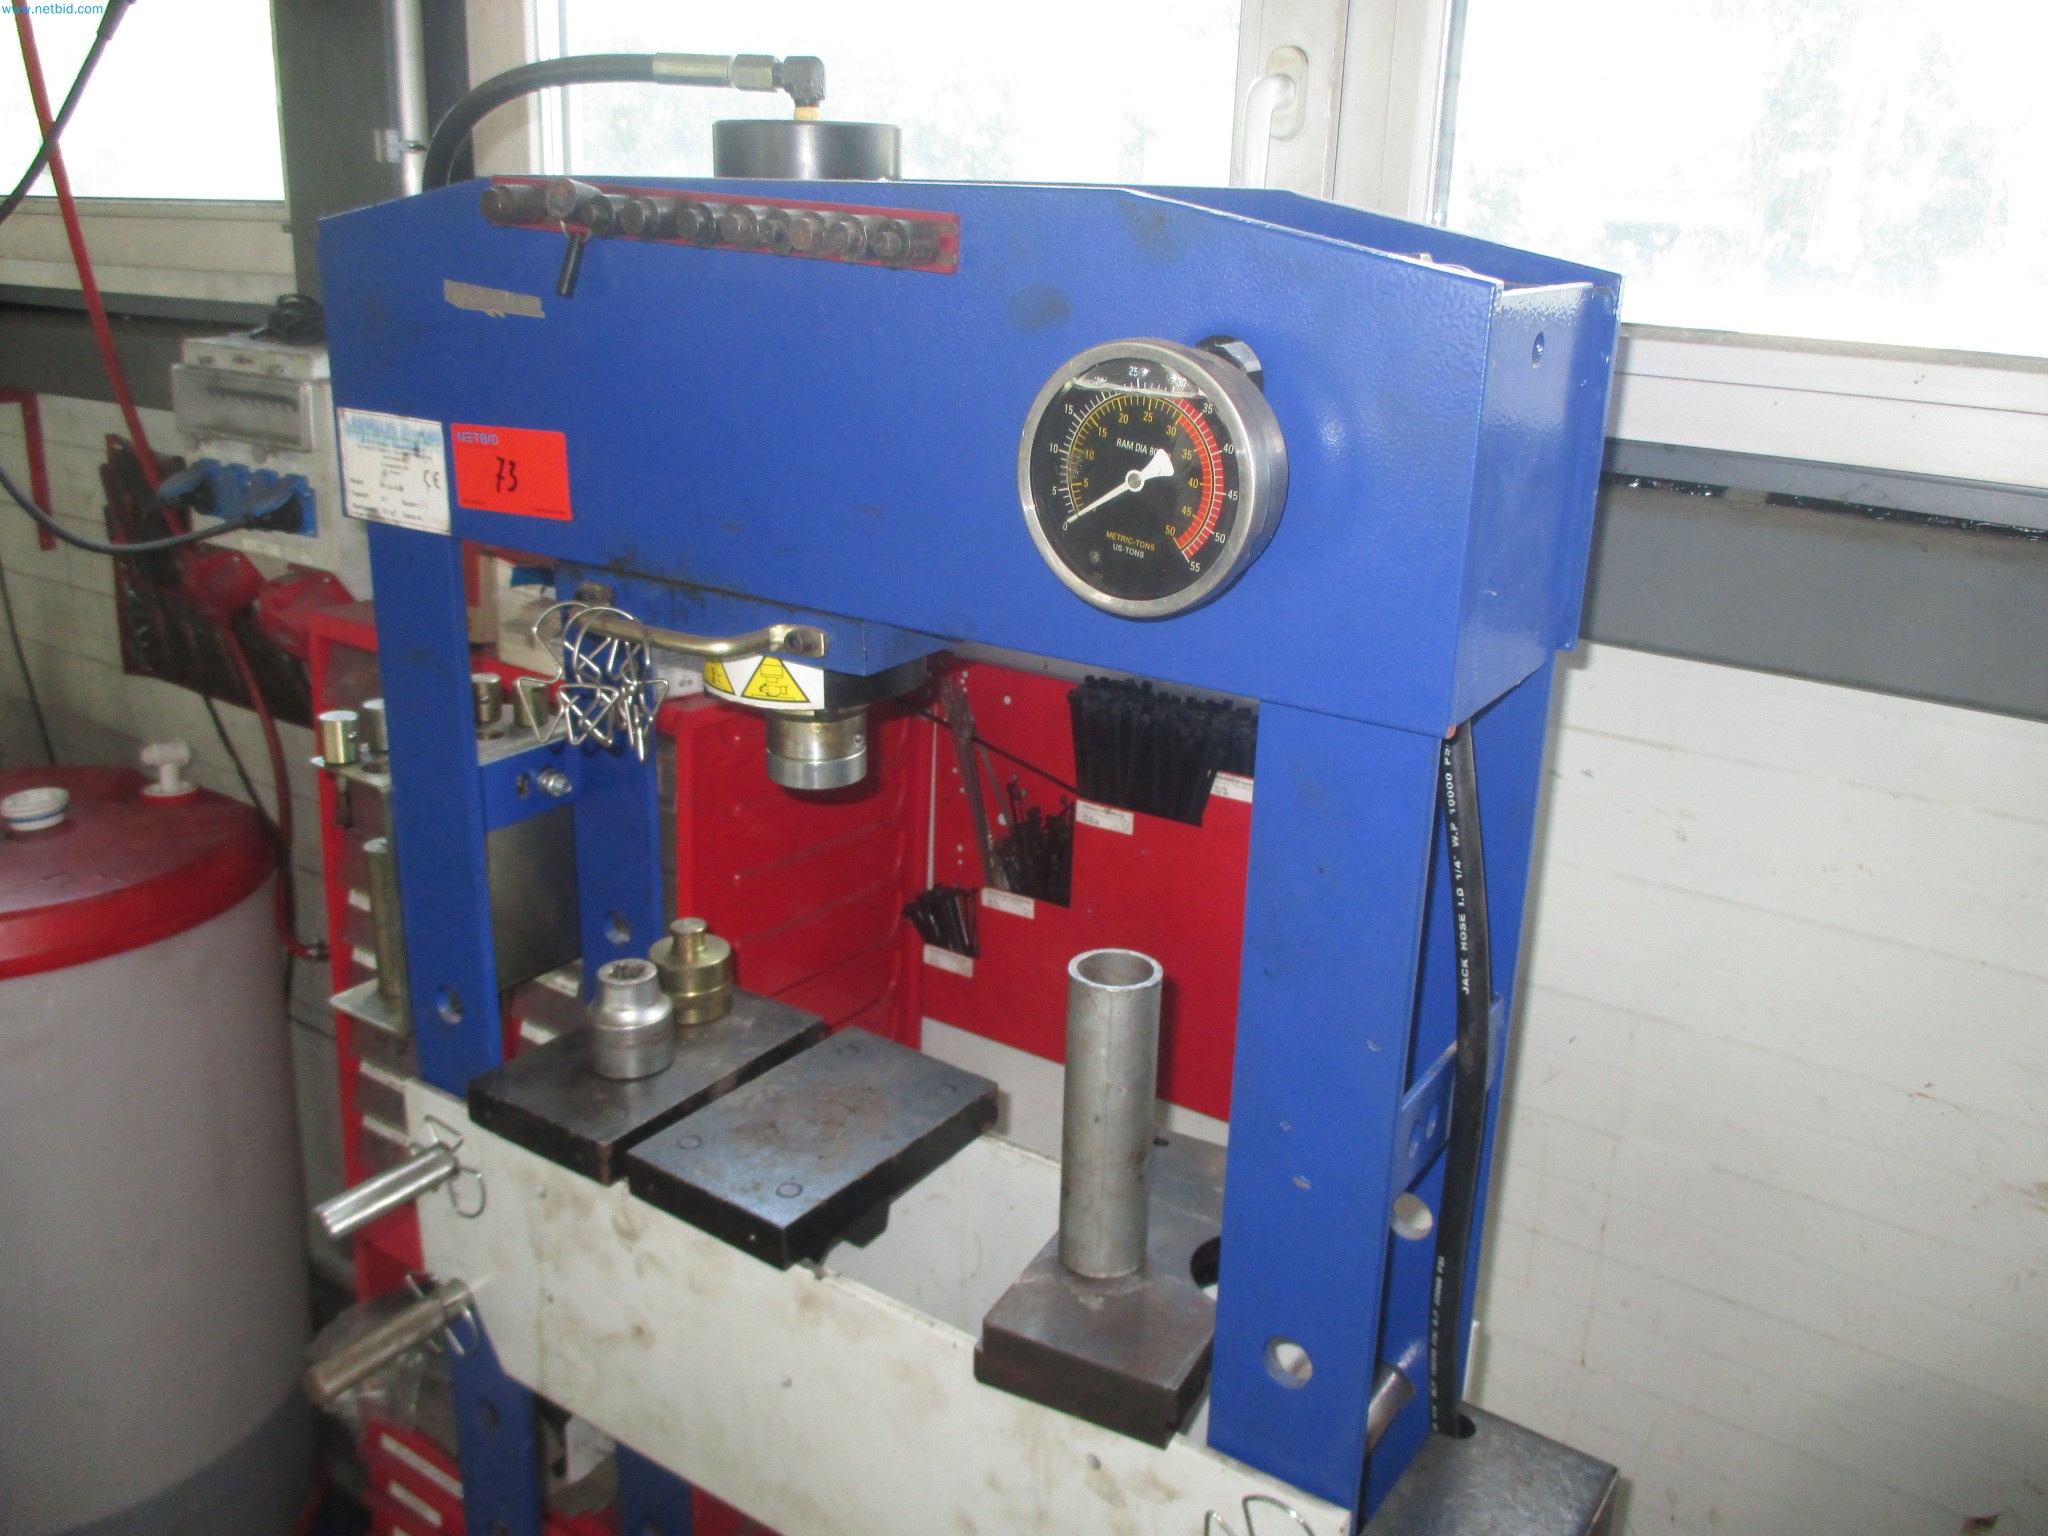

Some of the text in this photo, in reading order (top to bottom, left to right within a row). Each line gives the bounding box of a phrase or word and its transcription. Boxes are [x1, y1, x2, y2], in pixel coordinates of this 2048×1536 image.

[1128, 365, 1139, 378] 25
[1177, 377, 1187, 388] 30
[1064, 403, 1074, 415] 15
[1202, 402, 1214, 415] 35
[1118, 412, 1129, 424] 20
[1142, 411, 1153, 423] 25
[1098, 426, 1108, 438] 15
[1165, 425, 1177, 437] 30
[456, 431, 499, 446] NETBID
[1049, 443, 1059, 454] 10
[1116, 437, 1134, 451] RAM
[1134, 442, 1148, 455] DIA
[1222, 443, 1234, 455] 40
[1085, 449, 1095, 461] 10
[1181, 448, 1193, 460] 35
[495, 456, 518, 493] 73
[1083, 478, 1089, 488] 5
[1187, 478, 1199, 489] 40
[1051, 486, 1057, 496] 5
[1227, 489, 1239, 501] 45
[1181, 505, 1192, 517] 45
[1062, 521, 1068, 531] 0
[1165, 524, 1176, 537] 50
[1105, 530, 1156, 552] METRIC-TONS
[1214, 531, 1226, 544] 50
[1112, 543, 1145, 559] US-TONS
[1189, 561, 1200, 573] 55
[1444, 772, 1456, 816] 10000
[1450, 822, 1460, 848] W.P
[1458, 913, 1468, 951] HOSE
[1460, 958, 1470, 996] JACK
